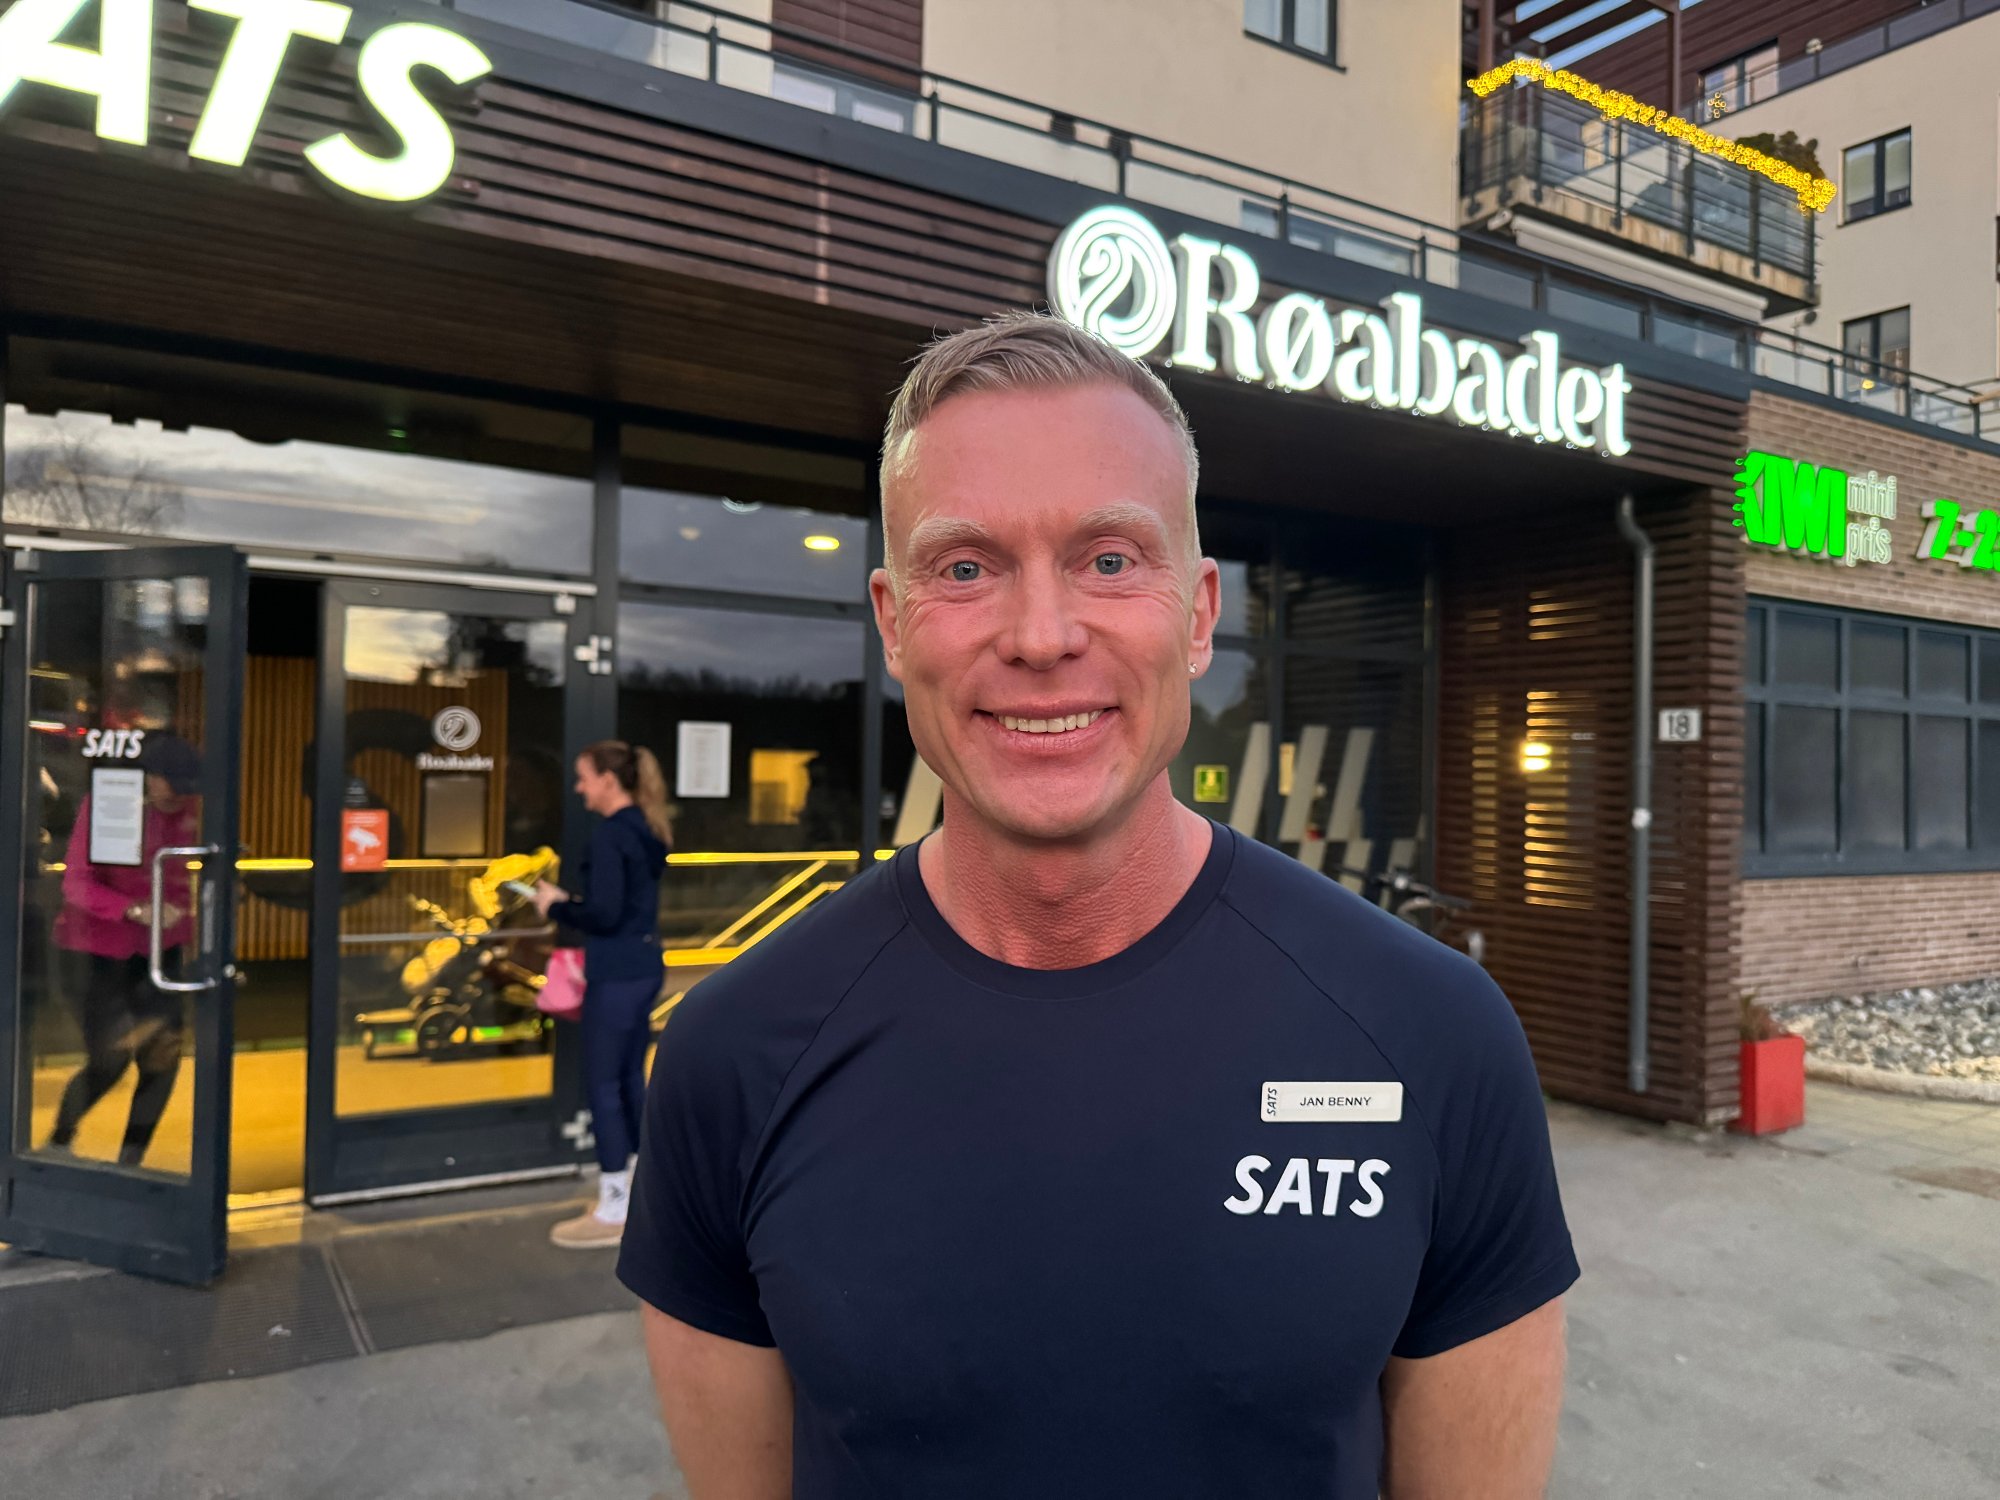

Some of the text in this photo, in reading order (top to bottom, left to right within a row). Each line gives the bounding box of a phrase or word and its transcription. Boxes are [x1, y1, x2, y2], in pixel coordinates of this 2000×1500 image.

[1171, 232, 1633, 458] Røabadet
[1741, 450, 1847, 557] KIWI
[1847, 470, 1897, 520] mini
[1845, 516, 1893, 568] pris
[1927, 498, 2000, 573] 7-2
[82, 728, 145, 759] SATS
[1668, 713, 1690, 739] 18
[1266, 1087, 1278, 1117] SATS
[1300, 1096, 1372, 1106] JAN BENNY
[1223, 1155, 1391, 1218] SATS
